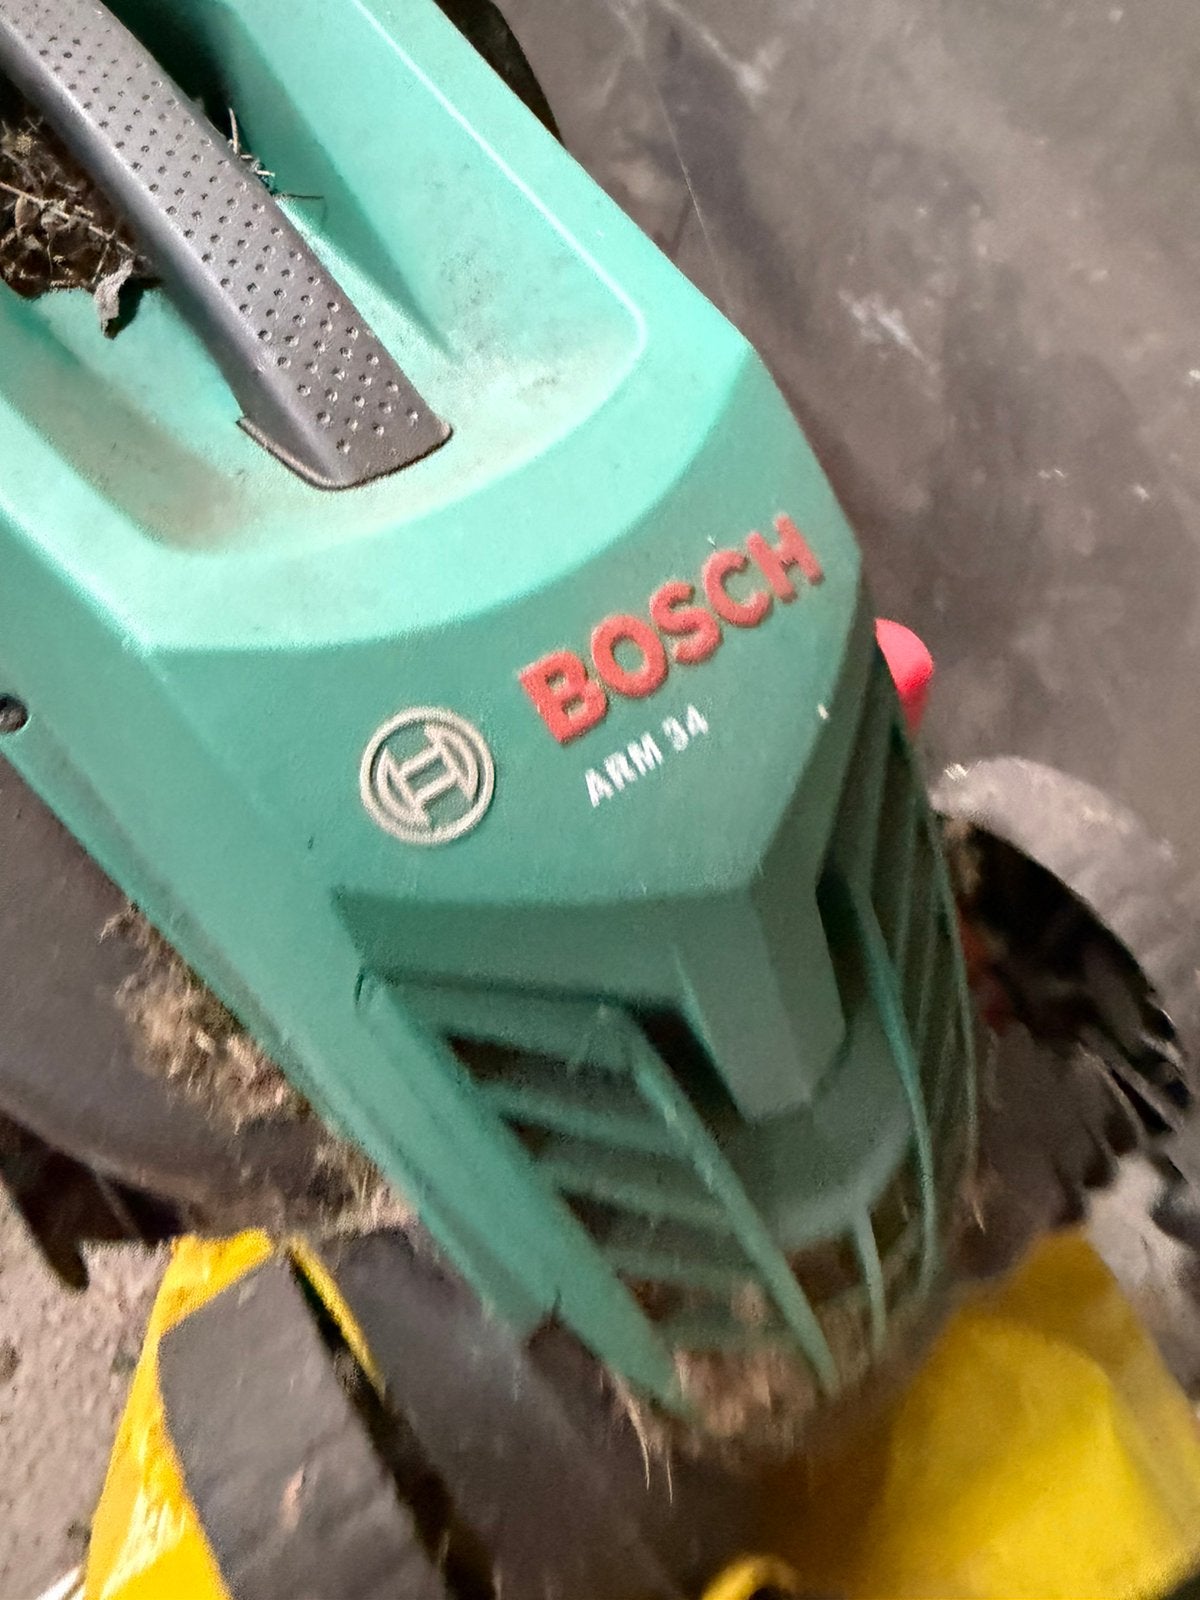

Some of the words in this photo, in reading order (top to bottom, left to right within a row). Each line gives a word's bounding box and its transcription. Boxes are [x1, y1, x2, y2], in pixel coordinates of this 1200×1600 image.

[519, 514, 823, 744] BOSCH
[584, 731, 664, 808] ARM
[661, 703, 709, 752] 34
